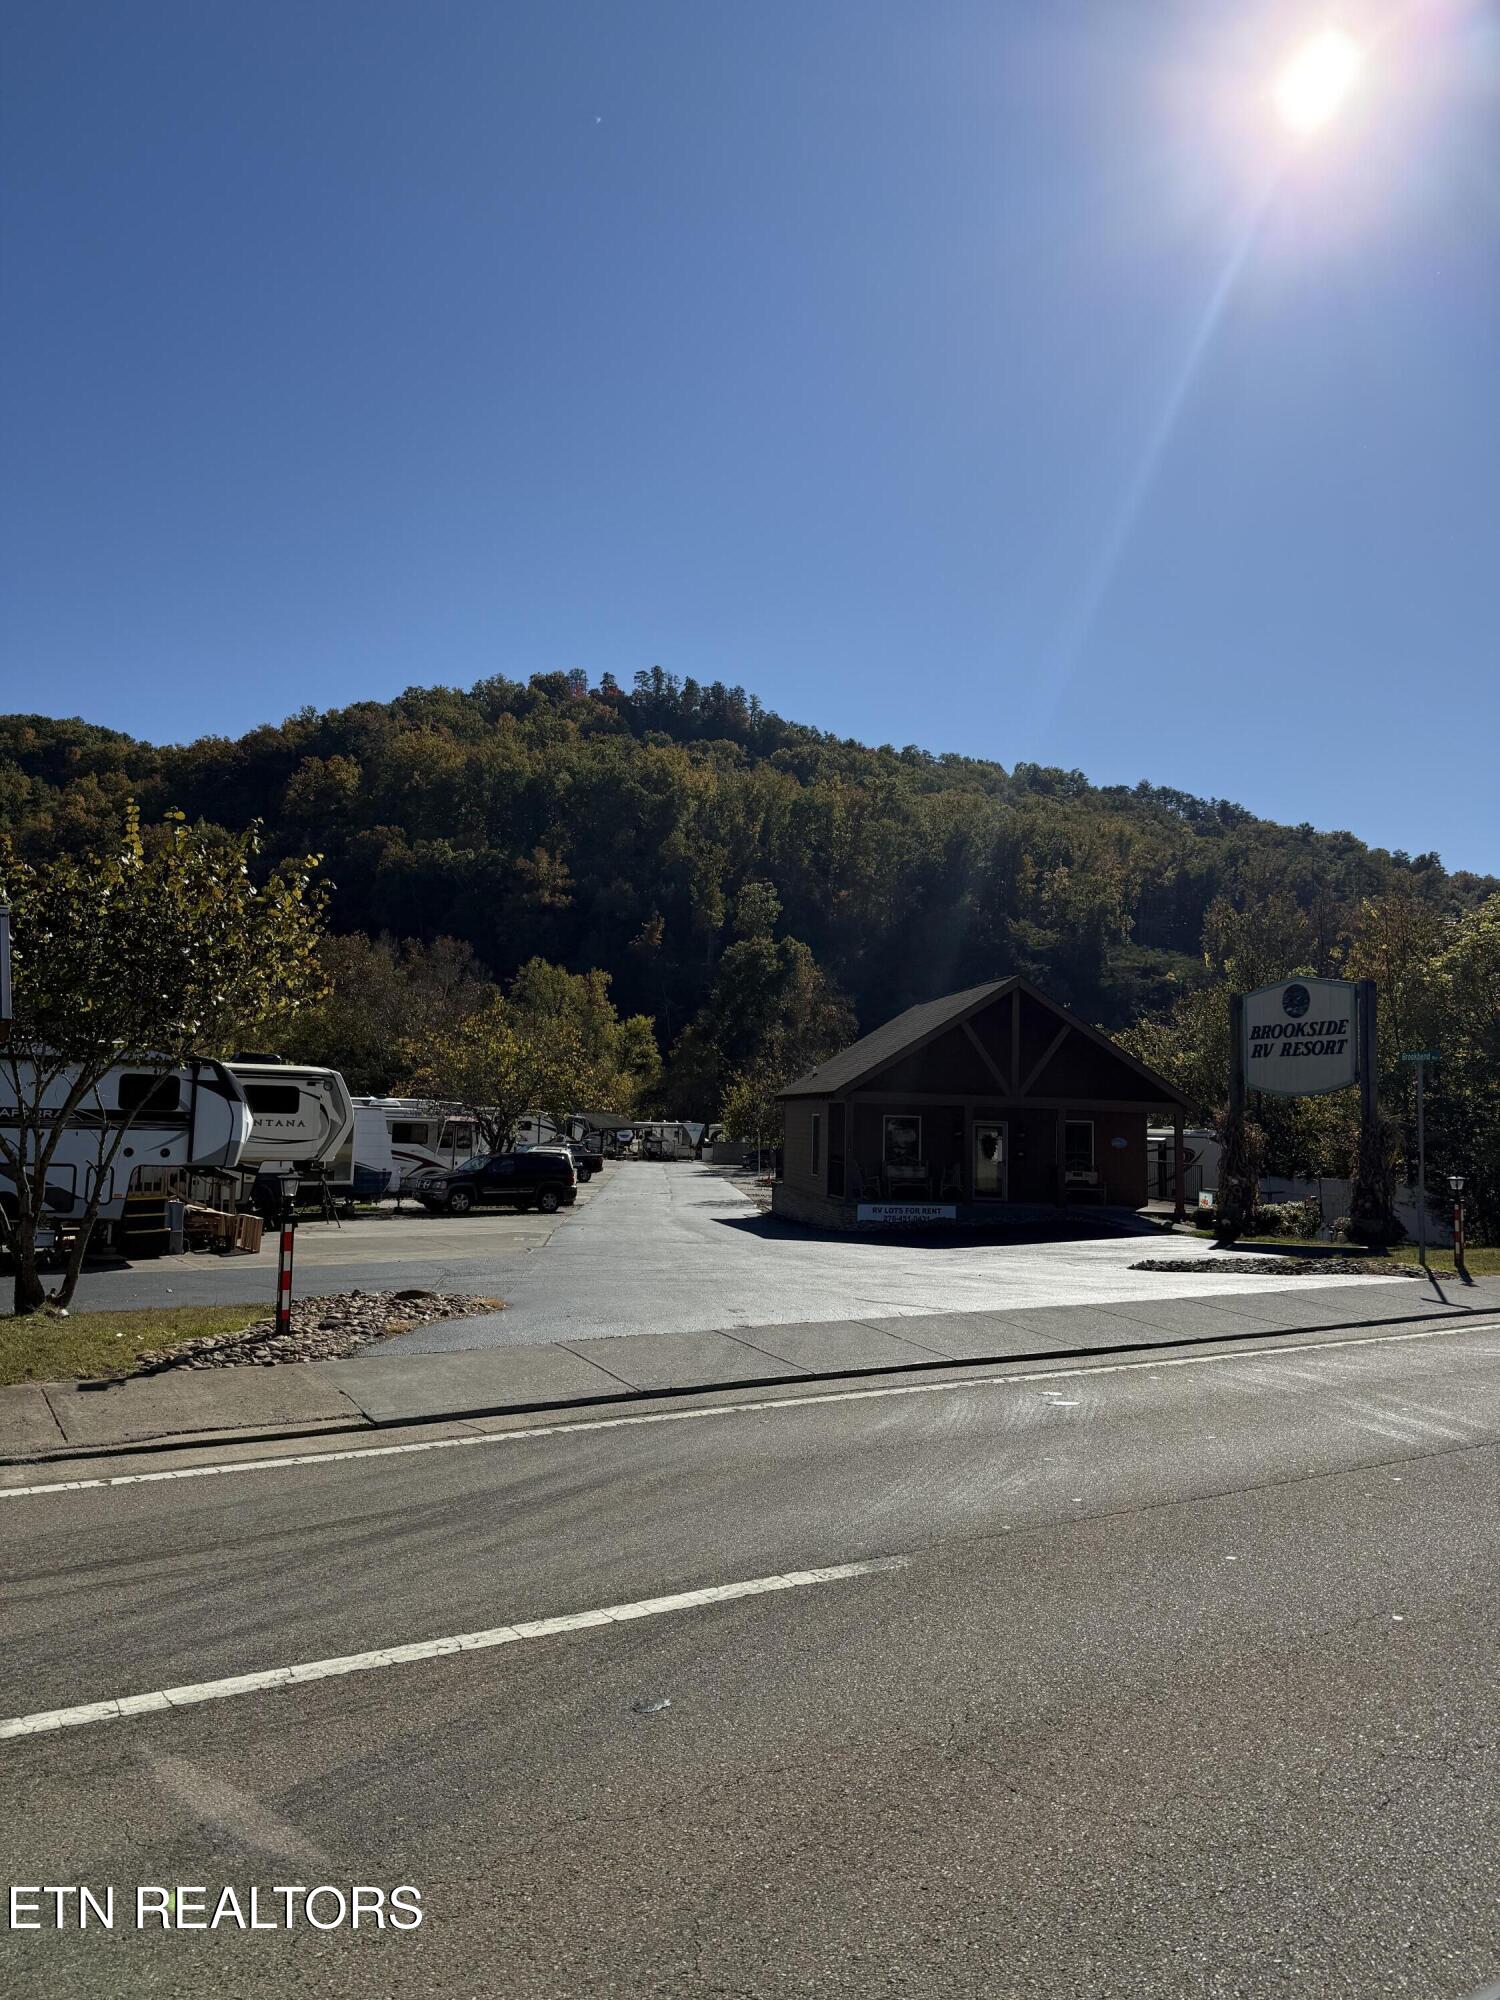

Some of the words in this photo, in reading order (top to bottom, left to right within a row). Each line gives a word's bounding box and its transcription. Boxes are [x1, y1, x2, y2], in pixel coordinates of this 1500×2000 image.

[1249, 1018, 1349, 1041] BROOKSIDE
[1251, 1043, 1274, 1058] RV
[1279, 1039, 1348, 1057] RESORT
[872, 1206, 883, 1214] RV
[884, 1206, 903, 1214] LOTS
[905, 1206, 920, 1215] FOR
[922, 1207, 942, 1215] RENT
